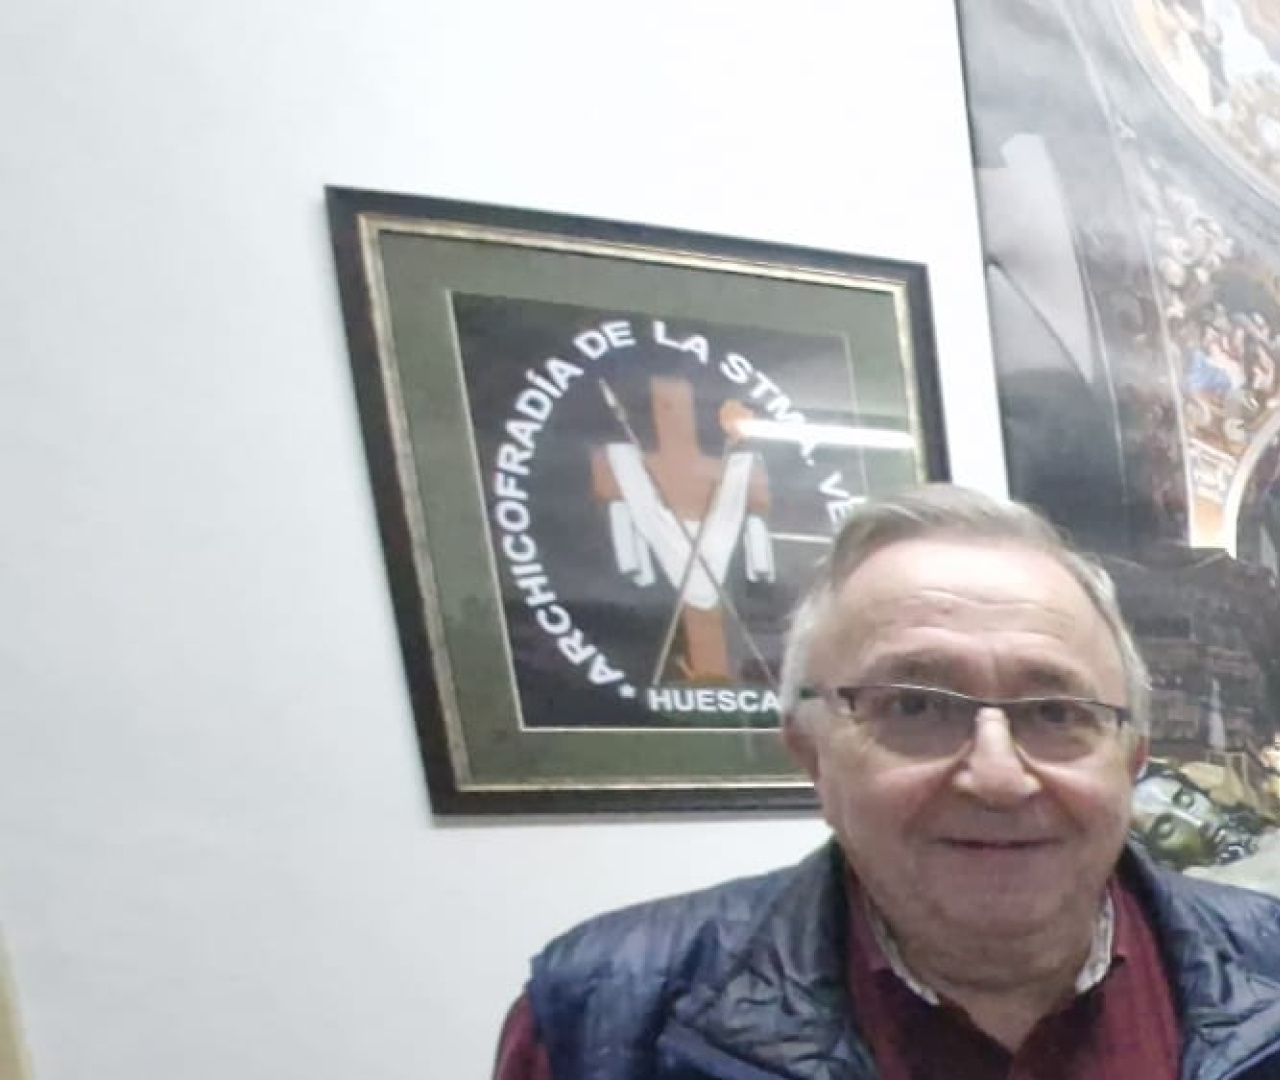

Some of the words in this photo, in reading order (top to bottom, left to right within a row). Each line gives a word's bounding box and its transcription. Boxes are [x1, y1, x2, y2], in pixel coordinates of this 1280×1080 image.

[573, 320, 636, 361] DE
[654, 320, 709, 363] LA
[649, 686, 782, 713] HUESCA
